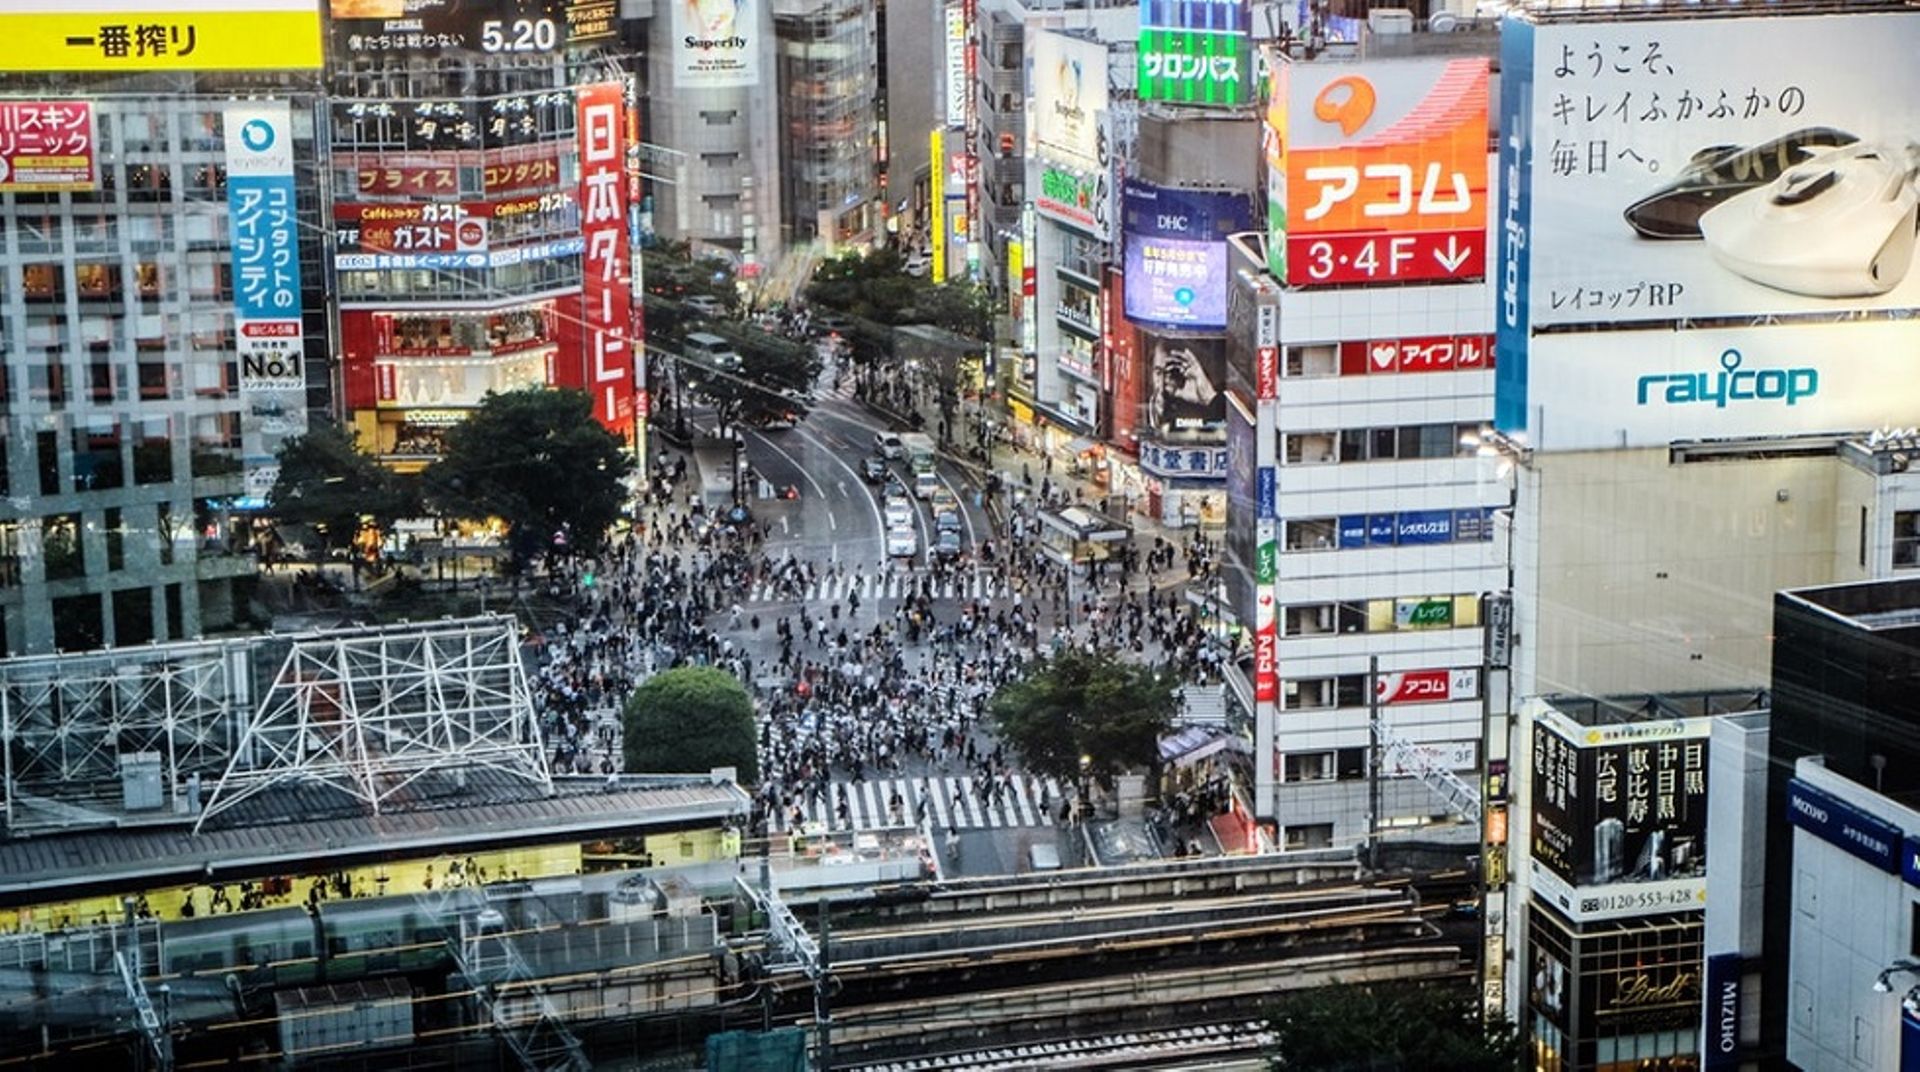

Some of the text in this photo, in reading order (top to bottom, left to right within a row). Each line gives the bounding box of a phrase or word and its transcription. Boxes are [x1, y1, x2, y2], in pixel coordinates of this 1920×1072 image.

[66, 25, 196, 57] 一番搾り
[481, 18, 557, 52] 5.20
[684, 35, 747, 51] Superfly
[1142, 51, 1240, 83] サロンパス
[1554, 42, 1674, 78] ようこそ、
[1552, 86, 1805, 125] キレイふかふかの
[484, 159, 557, 186] コンタクト
[1551, 138, 1660, 177] 毎日へ。
[540, 193, 574, 213] ガスト
[1304, 162, 1472, 222] アコム
[422, 204, 469, 222] ガスト
[1157, 214, 1188, 231] DHC
[337, 230, 359, 245] 7F
[393, 225, 452, 249] ガスト
[1504, 135, 1527, 327] raycop
[236, 188, 269, 309] アイシティ
[268, 187, 294, 309] コンタクトの
[584, 103, 626, 422] 日本ダービー
[242, 352, 301, 378] No.1
[1402, 344, 1480, 365] アイフル
[1637, 348, 1818, 408] raycop
[1405, 679, 1446, 695] アコム
[1455, 677, 1473, 690] 4F
[1454, 749, 1473, 763] 3F
[1685, 743, 1704, 795] 目黒
[1597, 752, 1619, 803] 広尾
[1627, 747, 1650, 824] 恵比寿
[1657, 743, 1678, 819] 中目黒
[1792, 795, 1829, 823] MIZUHO
[1602, 889, 1692, 910] 0120-553-428
[1609, 971, 1699, 1006] Lindt
[1720, 981, 1738, 1053] MIZUHO
